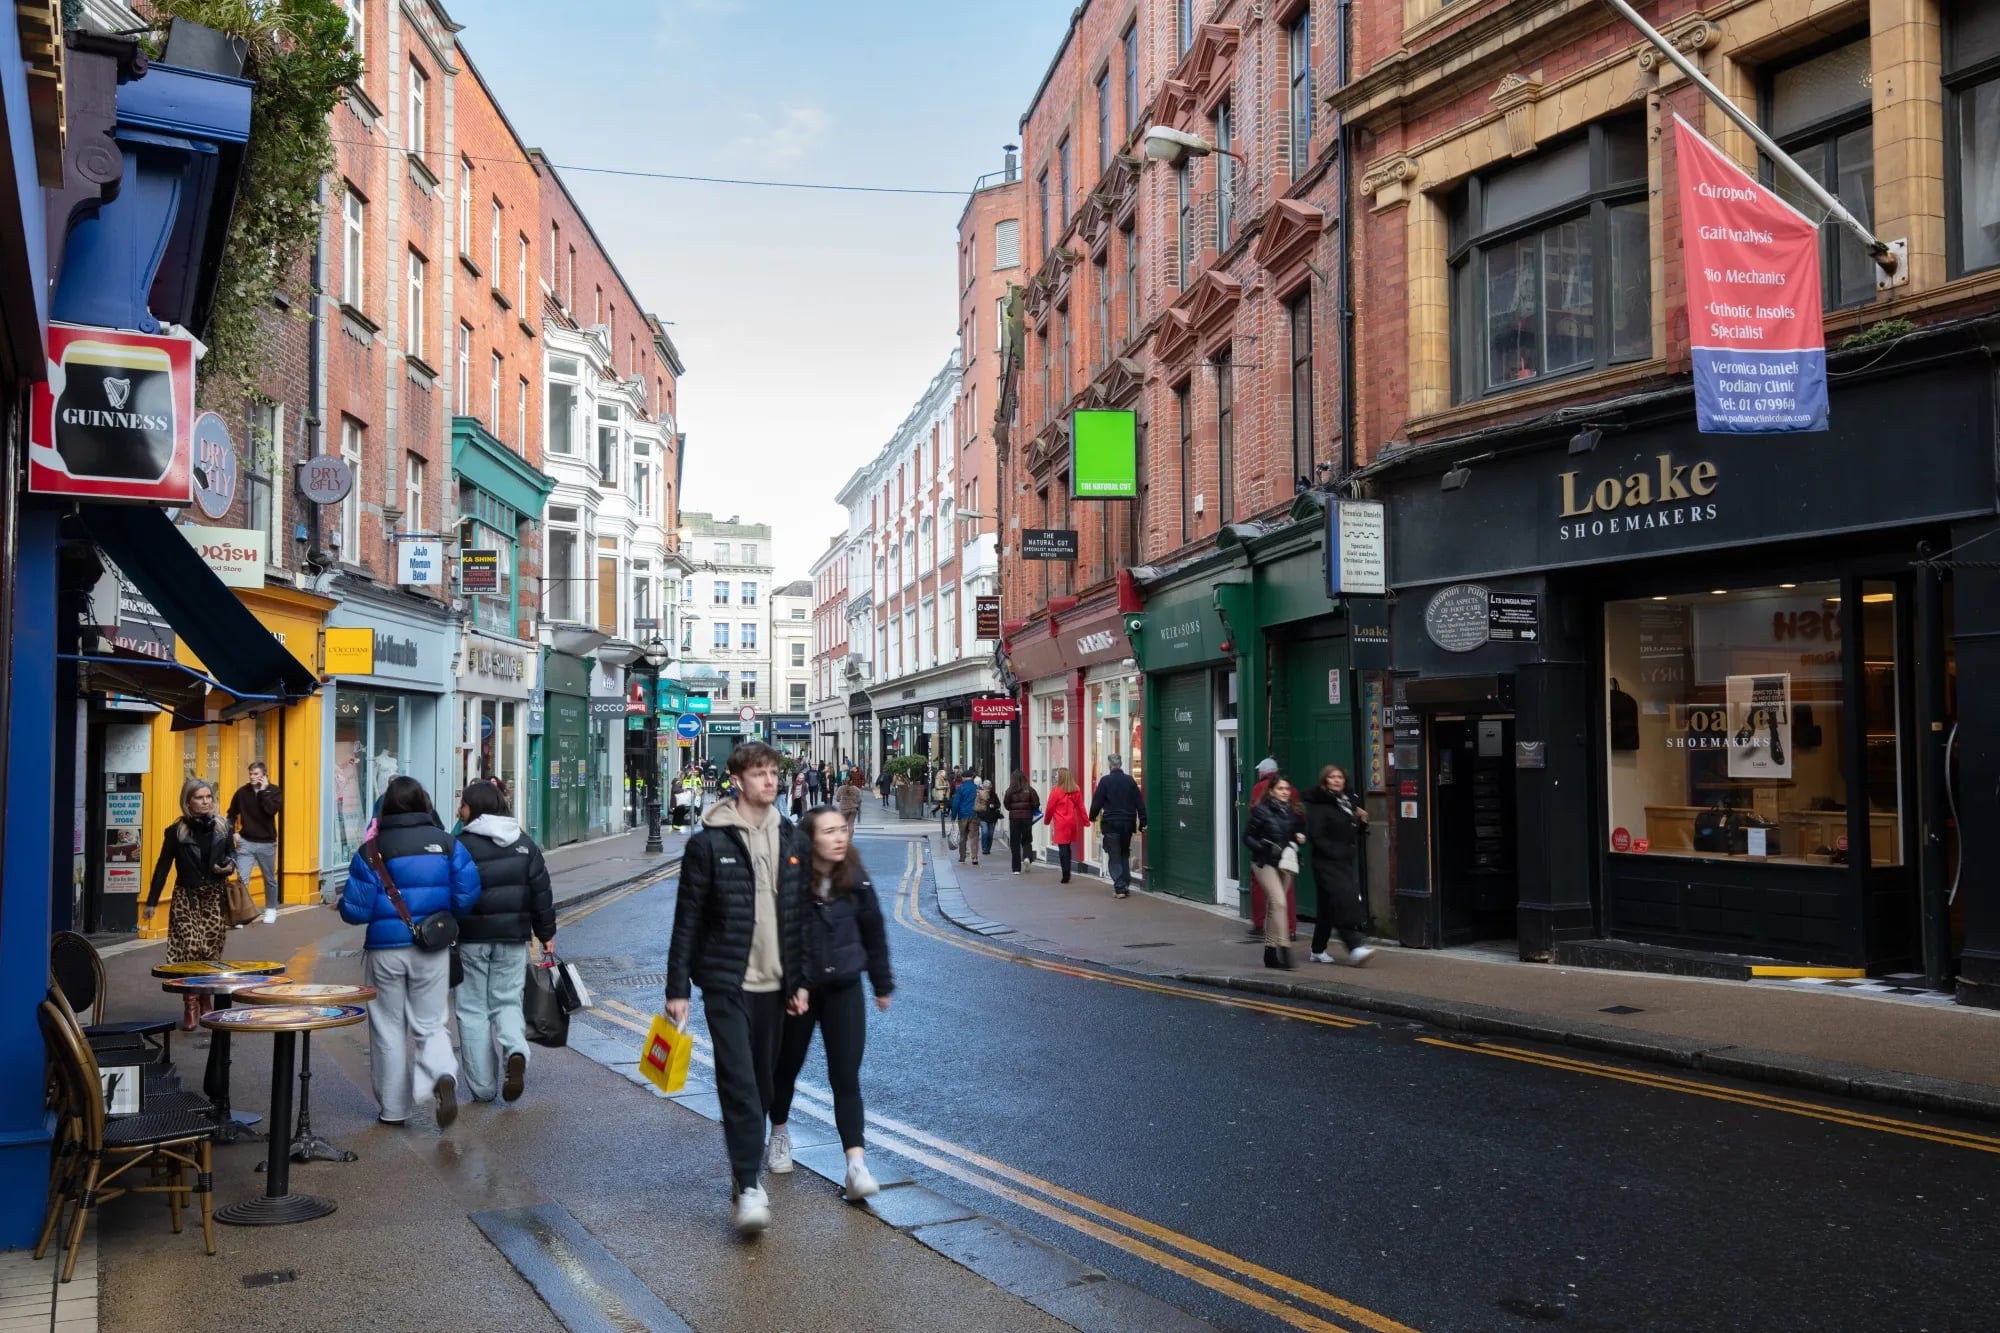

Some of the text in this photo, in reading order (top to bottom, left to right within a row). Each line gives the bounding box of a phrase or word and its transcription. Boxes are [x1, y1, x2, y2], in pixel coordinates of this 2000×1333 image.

[1700, 225, 1773, 245] Gait Analysis
[1726, 269, 1786, 286] Mechanics
[1756, 304, 1796, 320] Insoles
[1711, 322, 1764, 340] Specialist
[1711, 360, 1799, 376] Veronica Daniels
[1719, 379, 1794, 395] Podiatry Clinic
[1718, 397, 1736, 411] Tel:
[1739, 398, 1750, 411] 01
[62, 407, 168, 431] GUINNESS
[200, 438, 229, 471] DRY
[311, 467, 340, 480] DRY
[1081, 482, 1092, 490] THE
[1119, 482, 1131, 490] CUT
[1558, 454, 1718, 518] Loake
[1560, 503, 1718, 541] SHOEMAKERS
[1057, 539, 1069, 547] CUT
[413, 546, 428, 557] JoJo
[1160, 626, 1178, 640] WEIR
[1181, 620, 1200, 636] SONS
[1354, 624, 1388, 636] Loake
[594, 703, 624, 712] ecco
[1174, 707, 1192, 725] Coming
[1669, 702, 1769, 732] Loake
[1178, 737, 1190, 752] Soon
[1370, 702, 1382, 787] TATTOO
[1667, 737, 1770, 748] SHOEMAKERS
